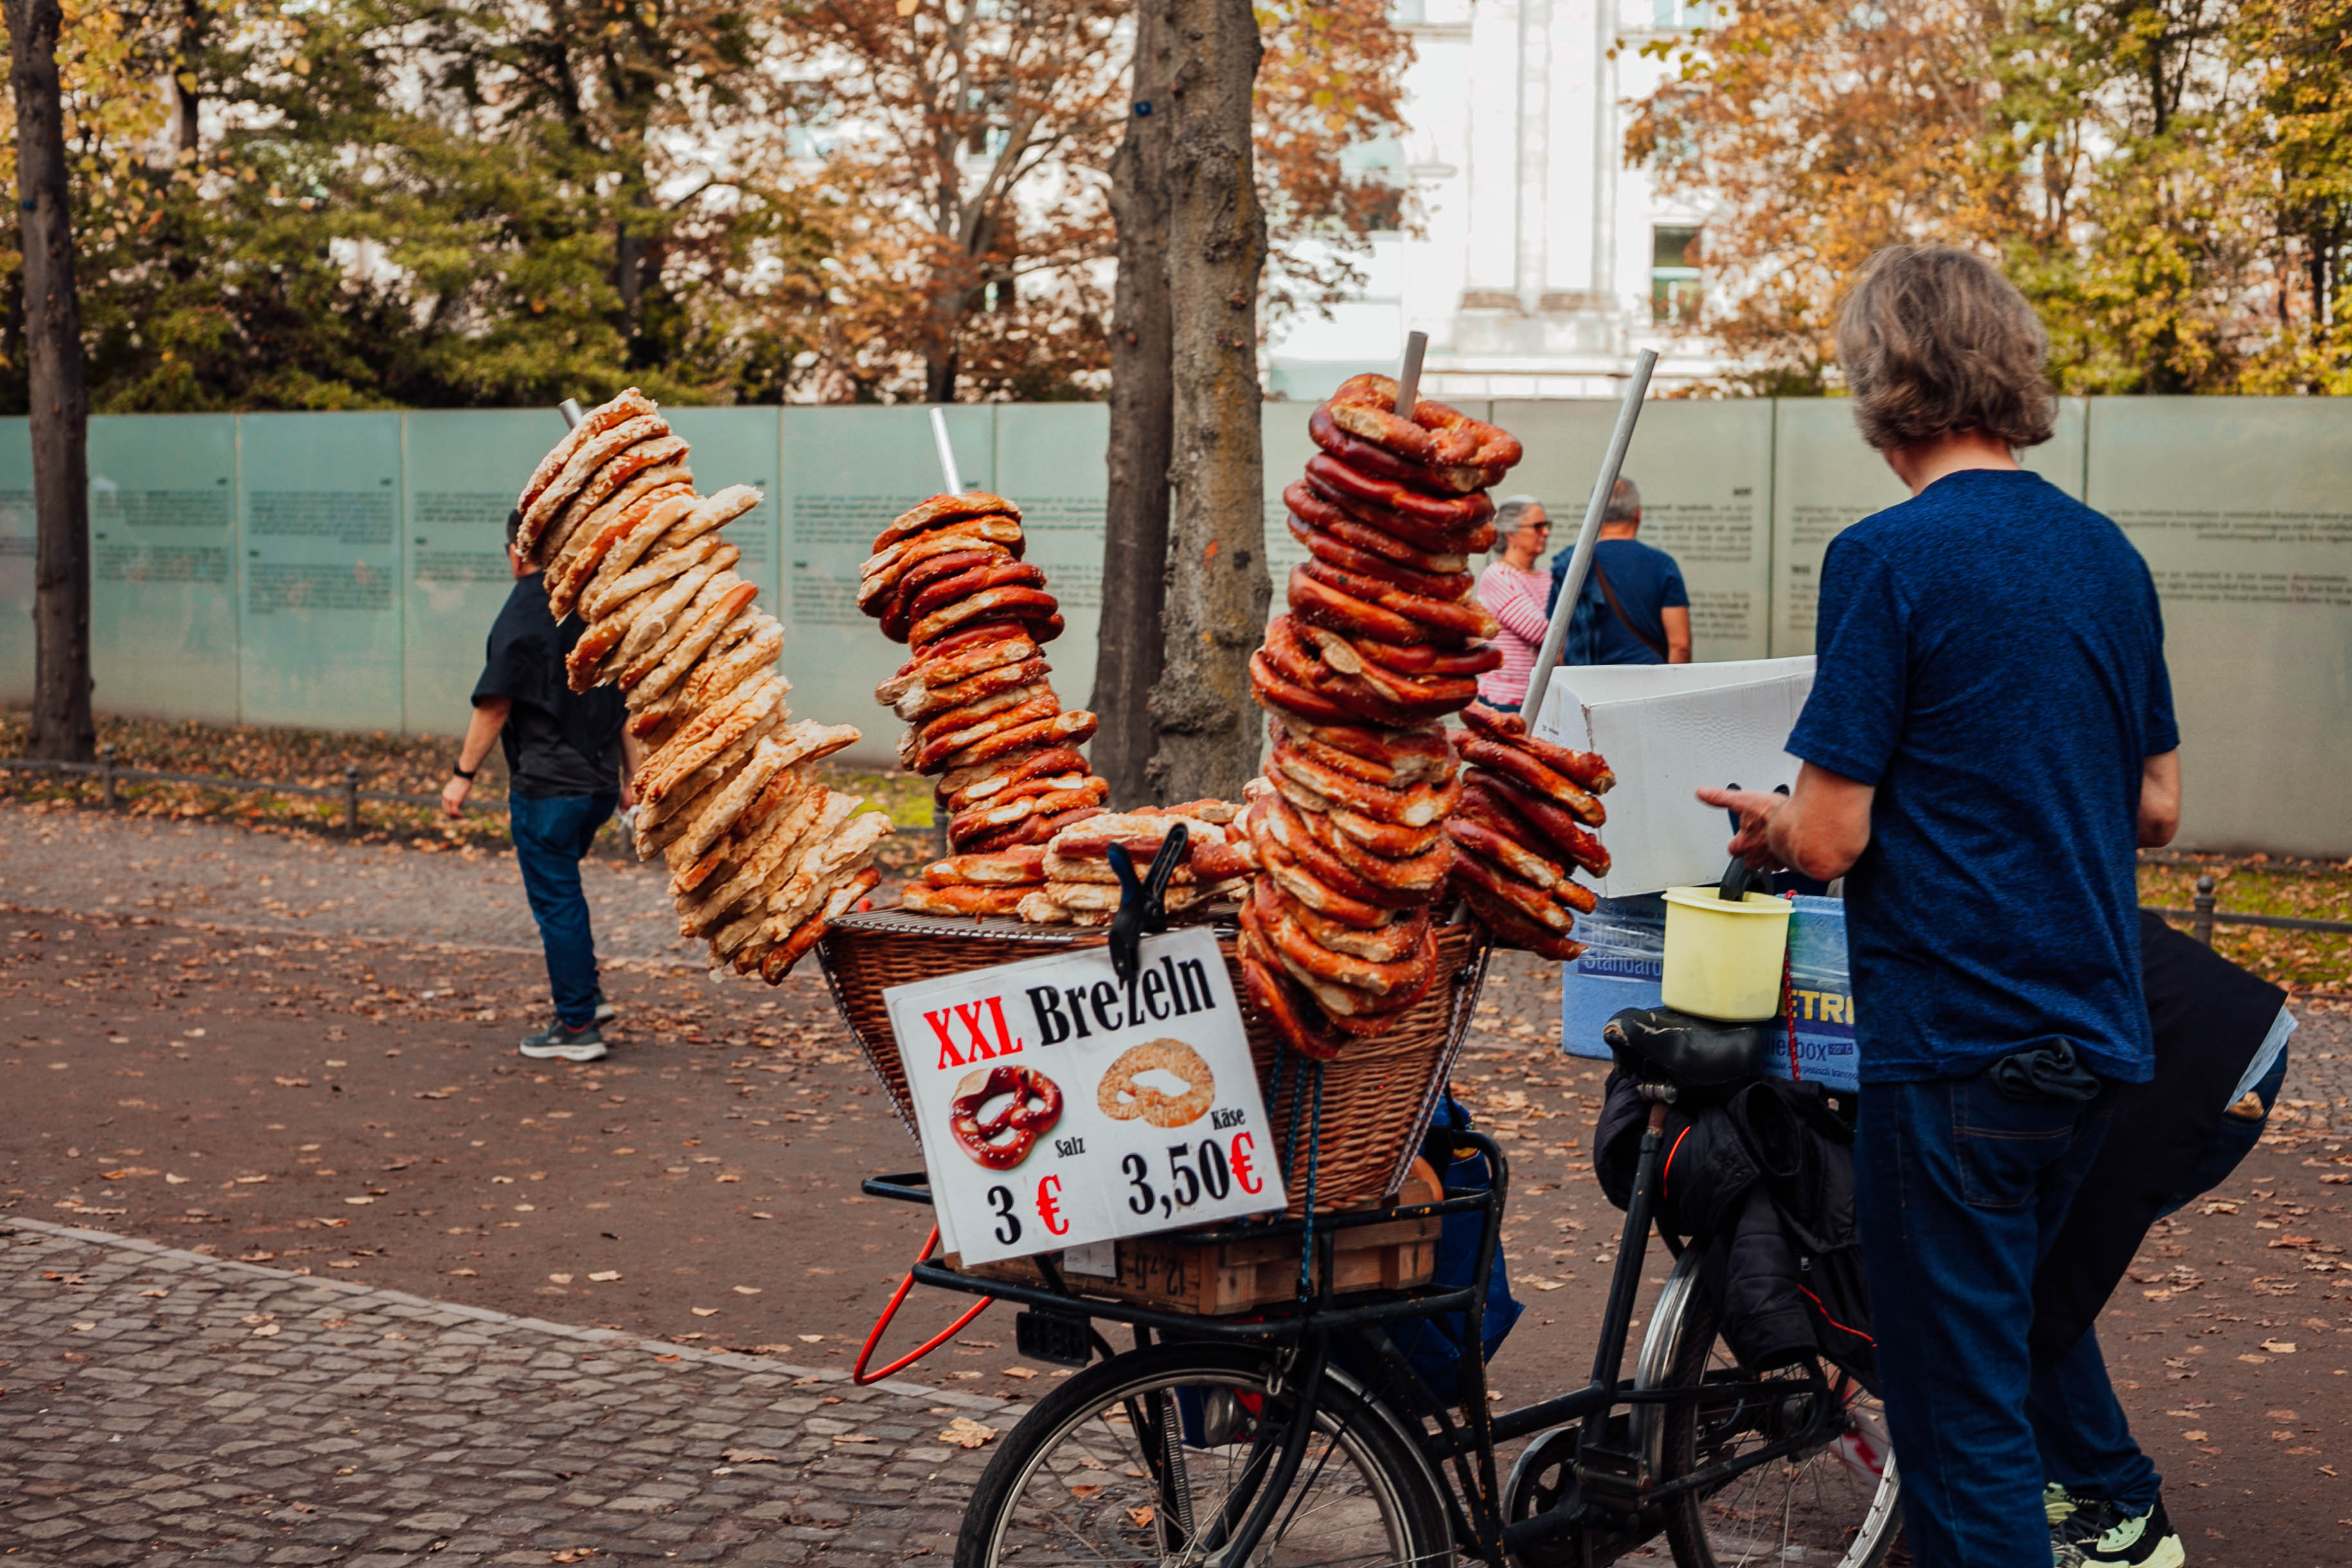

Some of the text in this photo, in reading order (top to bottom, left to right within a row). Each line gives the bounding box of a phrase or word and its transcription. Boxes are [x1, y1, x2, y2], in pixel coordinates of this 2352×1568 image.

[1584, 950, 1662, 977] Standard
[923, 955, 1216, 1069] XXL Brezeln
[1211, 1108, 1246, 1131] Käse
[1055, 1136, 1085, 1159] Salz
[988, 1174, 1069, 1245] 3 €
